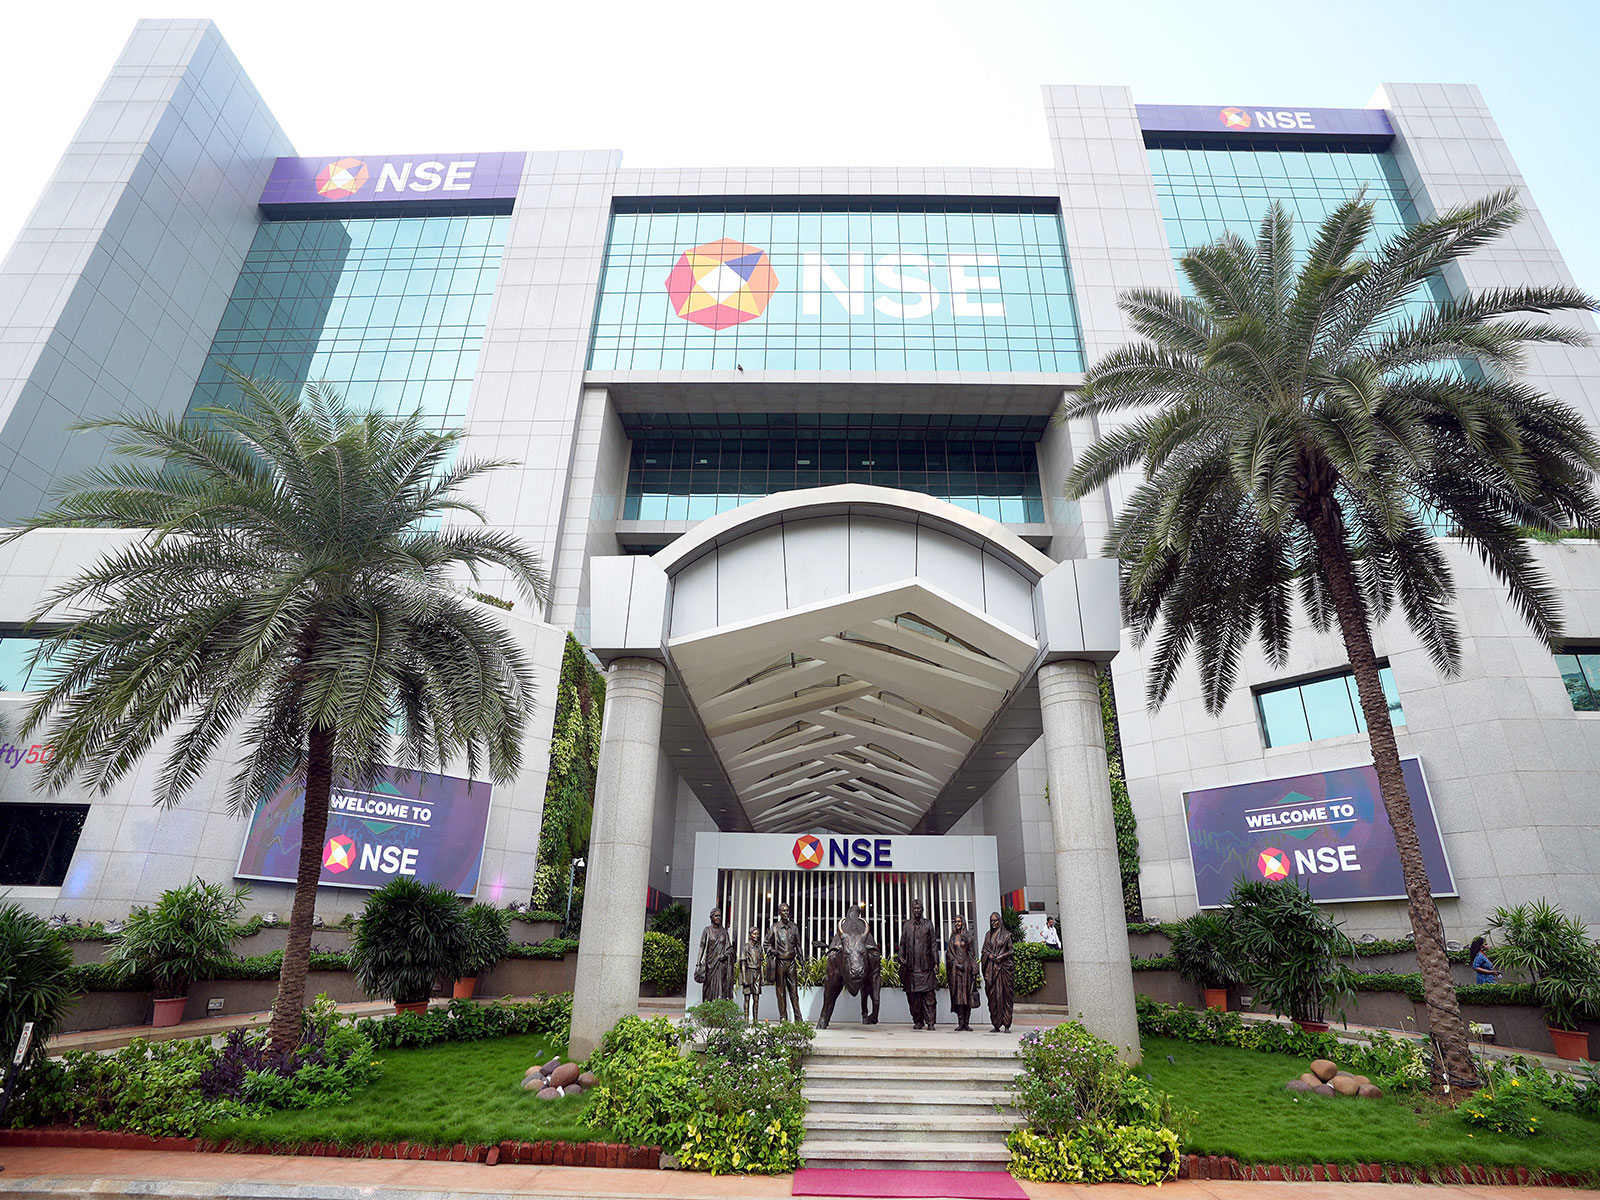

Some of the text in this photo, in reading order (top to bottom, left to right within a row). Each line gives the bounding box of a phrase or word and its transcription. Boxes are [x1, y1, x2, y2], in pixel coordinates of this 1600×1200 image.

[1254, 111, 1316, 129] NSE
[374, 160, 477, 193] NSE
[802, 251, 1007, 319] NSE
[0, 744, 56, 769] fty50
[330, 795, 432, 822] WELCOME TO
[1245, 804, 1355, 828] WELCOME TO
[360, 843, 419, 875] NSE
[829, 838, 892, 867] NSE
[1294, 845, 1361, 875] NSE
